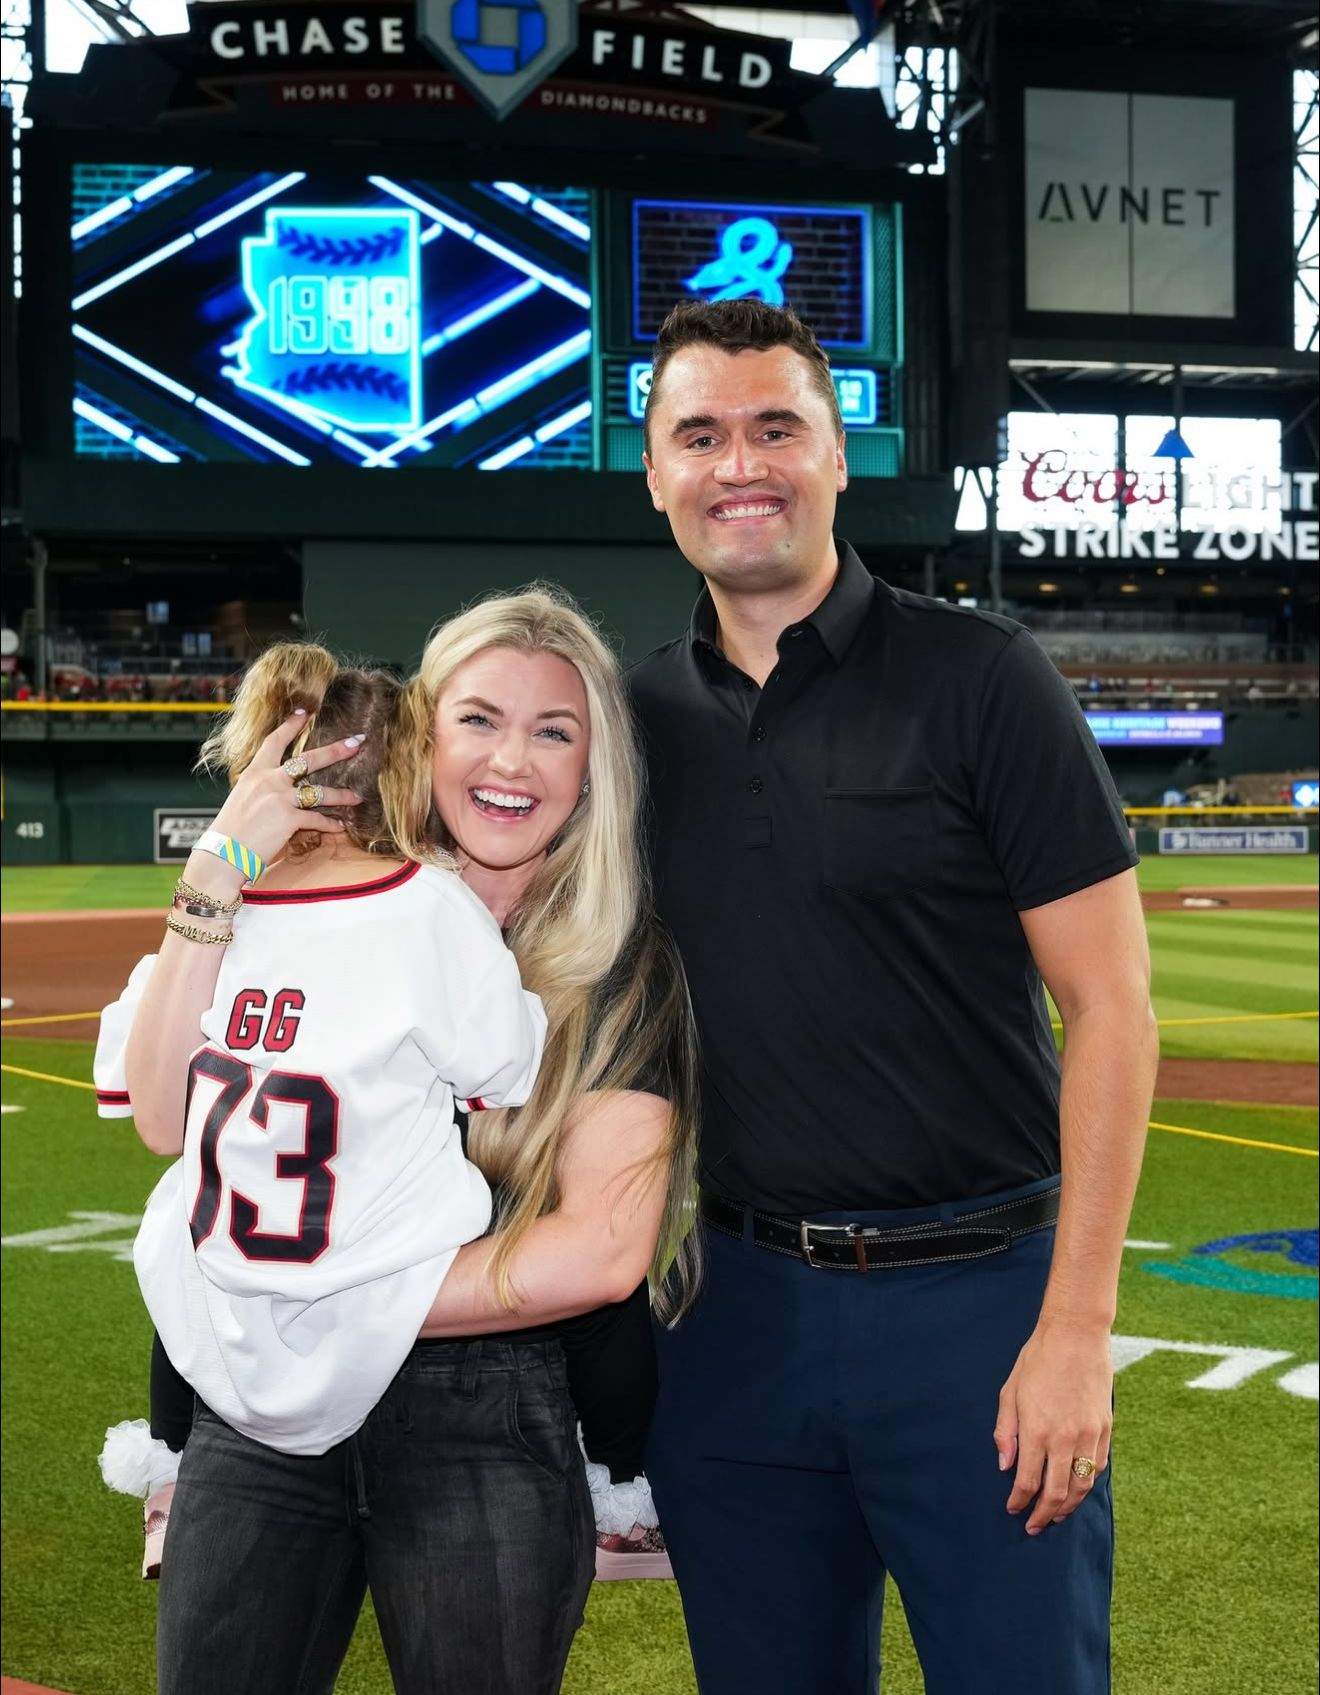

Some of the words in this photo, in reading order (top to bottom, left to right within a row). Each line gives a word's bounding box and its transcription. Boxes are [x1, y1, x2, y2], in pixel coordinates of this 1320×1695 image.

[210, 17, 404, 59] CHASE
[592, 30, 773, 89] FIELD
[282, 84, 348, 100] HOME
[366, 83, 395, 99] OF
[413, 83, 455, 100] THE
[541, 91, 707, 123] DIAMONDBACKS
[1038, 182, 1221, 227] AVNET
[268, 275, 410, 354] 1998
[1018, 520, 1180, 558] STRIKE
[1193, 521, 1318, 561] ZONE
[16, 821, 44, 839] 413
[225, 988, 306, 1053] GG
